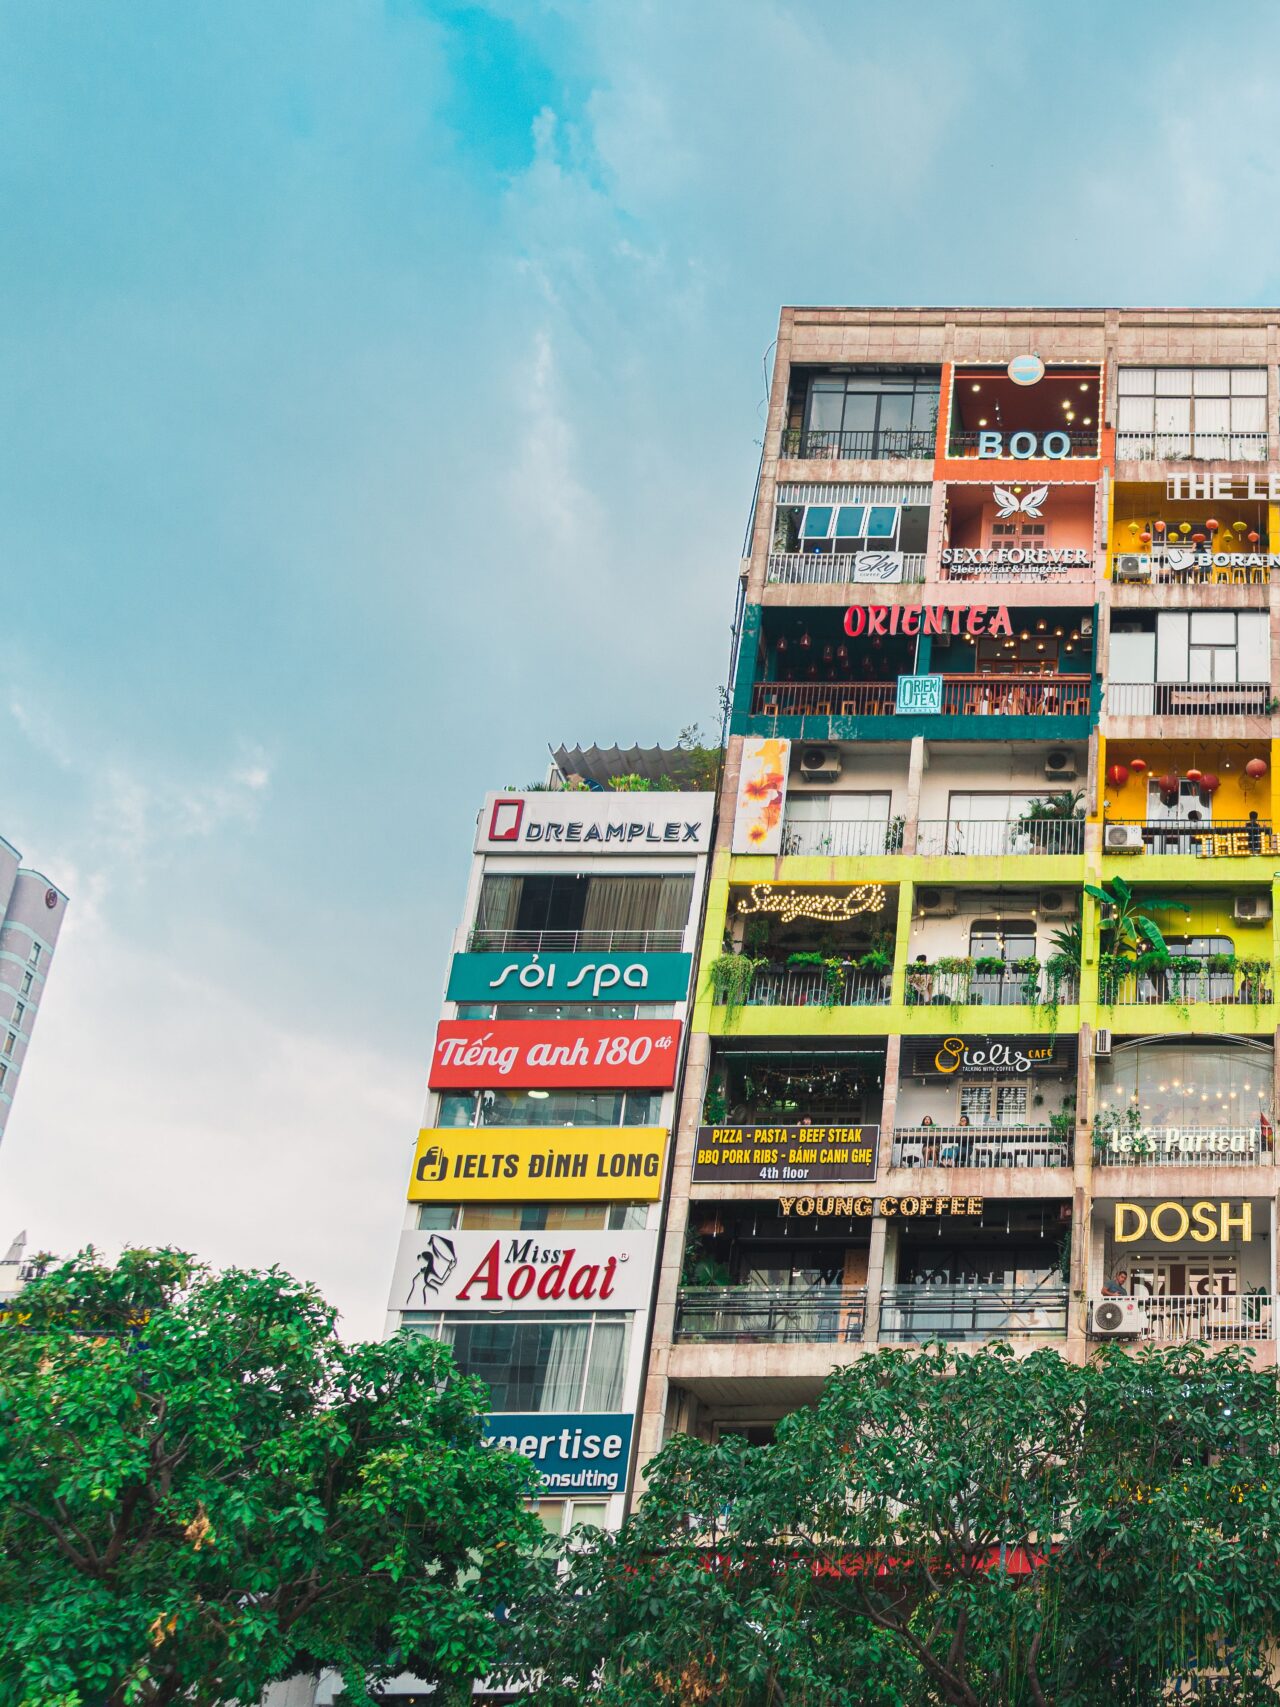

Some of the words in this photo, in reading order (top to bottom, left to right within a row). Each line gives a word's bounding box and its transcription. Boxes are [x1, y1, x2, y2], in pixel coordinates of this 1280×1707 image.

[979, 431, 1071, 459] BOO
[1167, 472, 1233, 500] THE
[858, 554, 899, 579] Sky
[941, 548, 996, 565] SEXY
[997, 548, 1090, 565] FOREVER
[1198, 553, 1264, 568] BORA
[843, 604, 1014, 637] ORIENTEA
[524, 821, 701, 843] DREAMPLEX
[1195, 832, 1250, 857] THE
[567, 963, 649, 997] spa
[438, 1033, 519, 1074] Tiếng
[594, 1036, 653, 1066] 180
[712, 1129, 743, 1144] PIZZA
[754, 1129, 788, 1143] PASTA
[799, 1128, 826, 1143] BEEF
[827, 1128, 862, 1143] STEAK
[453, 1154, 520, 1178] IELTS
[527, 1149, 588, 1178] ĐÌNH
[596, 1153, 660, 1177] LONG
[697, 1150, 719, 1164] BBQ
[721, 1149, 751, 1164] PORK
[753, 1149, 778, 1163] RIBS
[788, 1146, 817, 1163] BÁNH
[820, 1149, 849, 1163] CANH
[851, 1148, 873, 1166] GHẸ
[759, 1166, 779, 1179] 4th
[782, 1166, 809, 1179] floor
[778, 1196, 872, 1217] YOUNG
[879, 1195, 984, 1217] COFFEE
[1114, 1201, 1252, 1243] DOSH
[504, 1238, 562, 1264] Miss
[455, 1238, 619, 1301] Aodai
